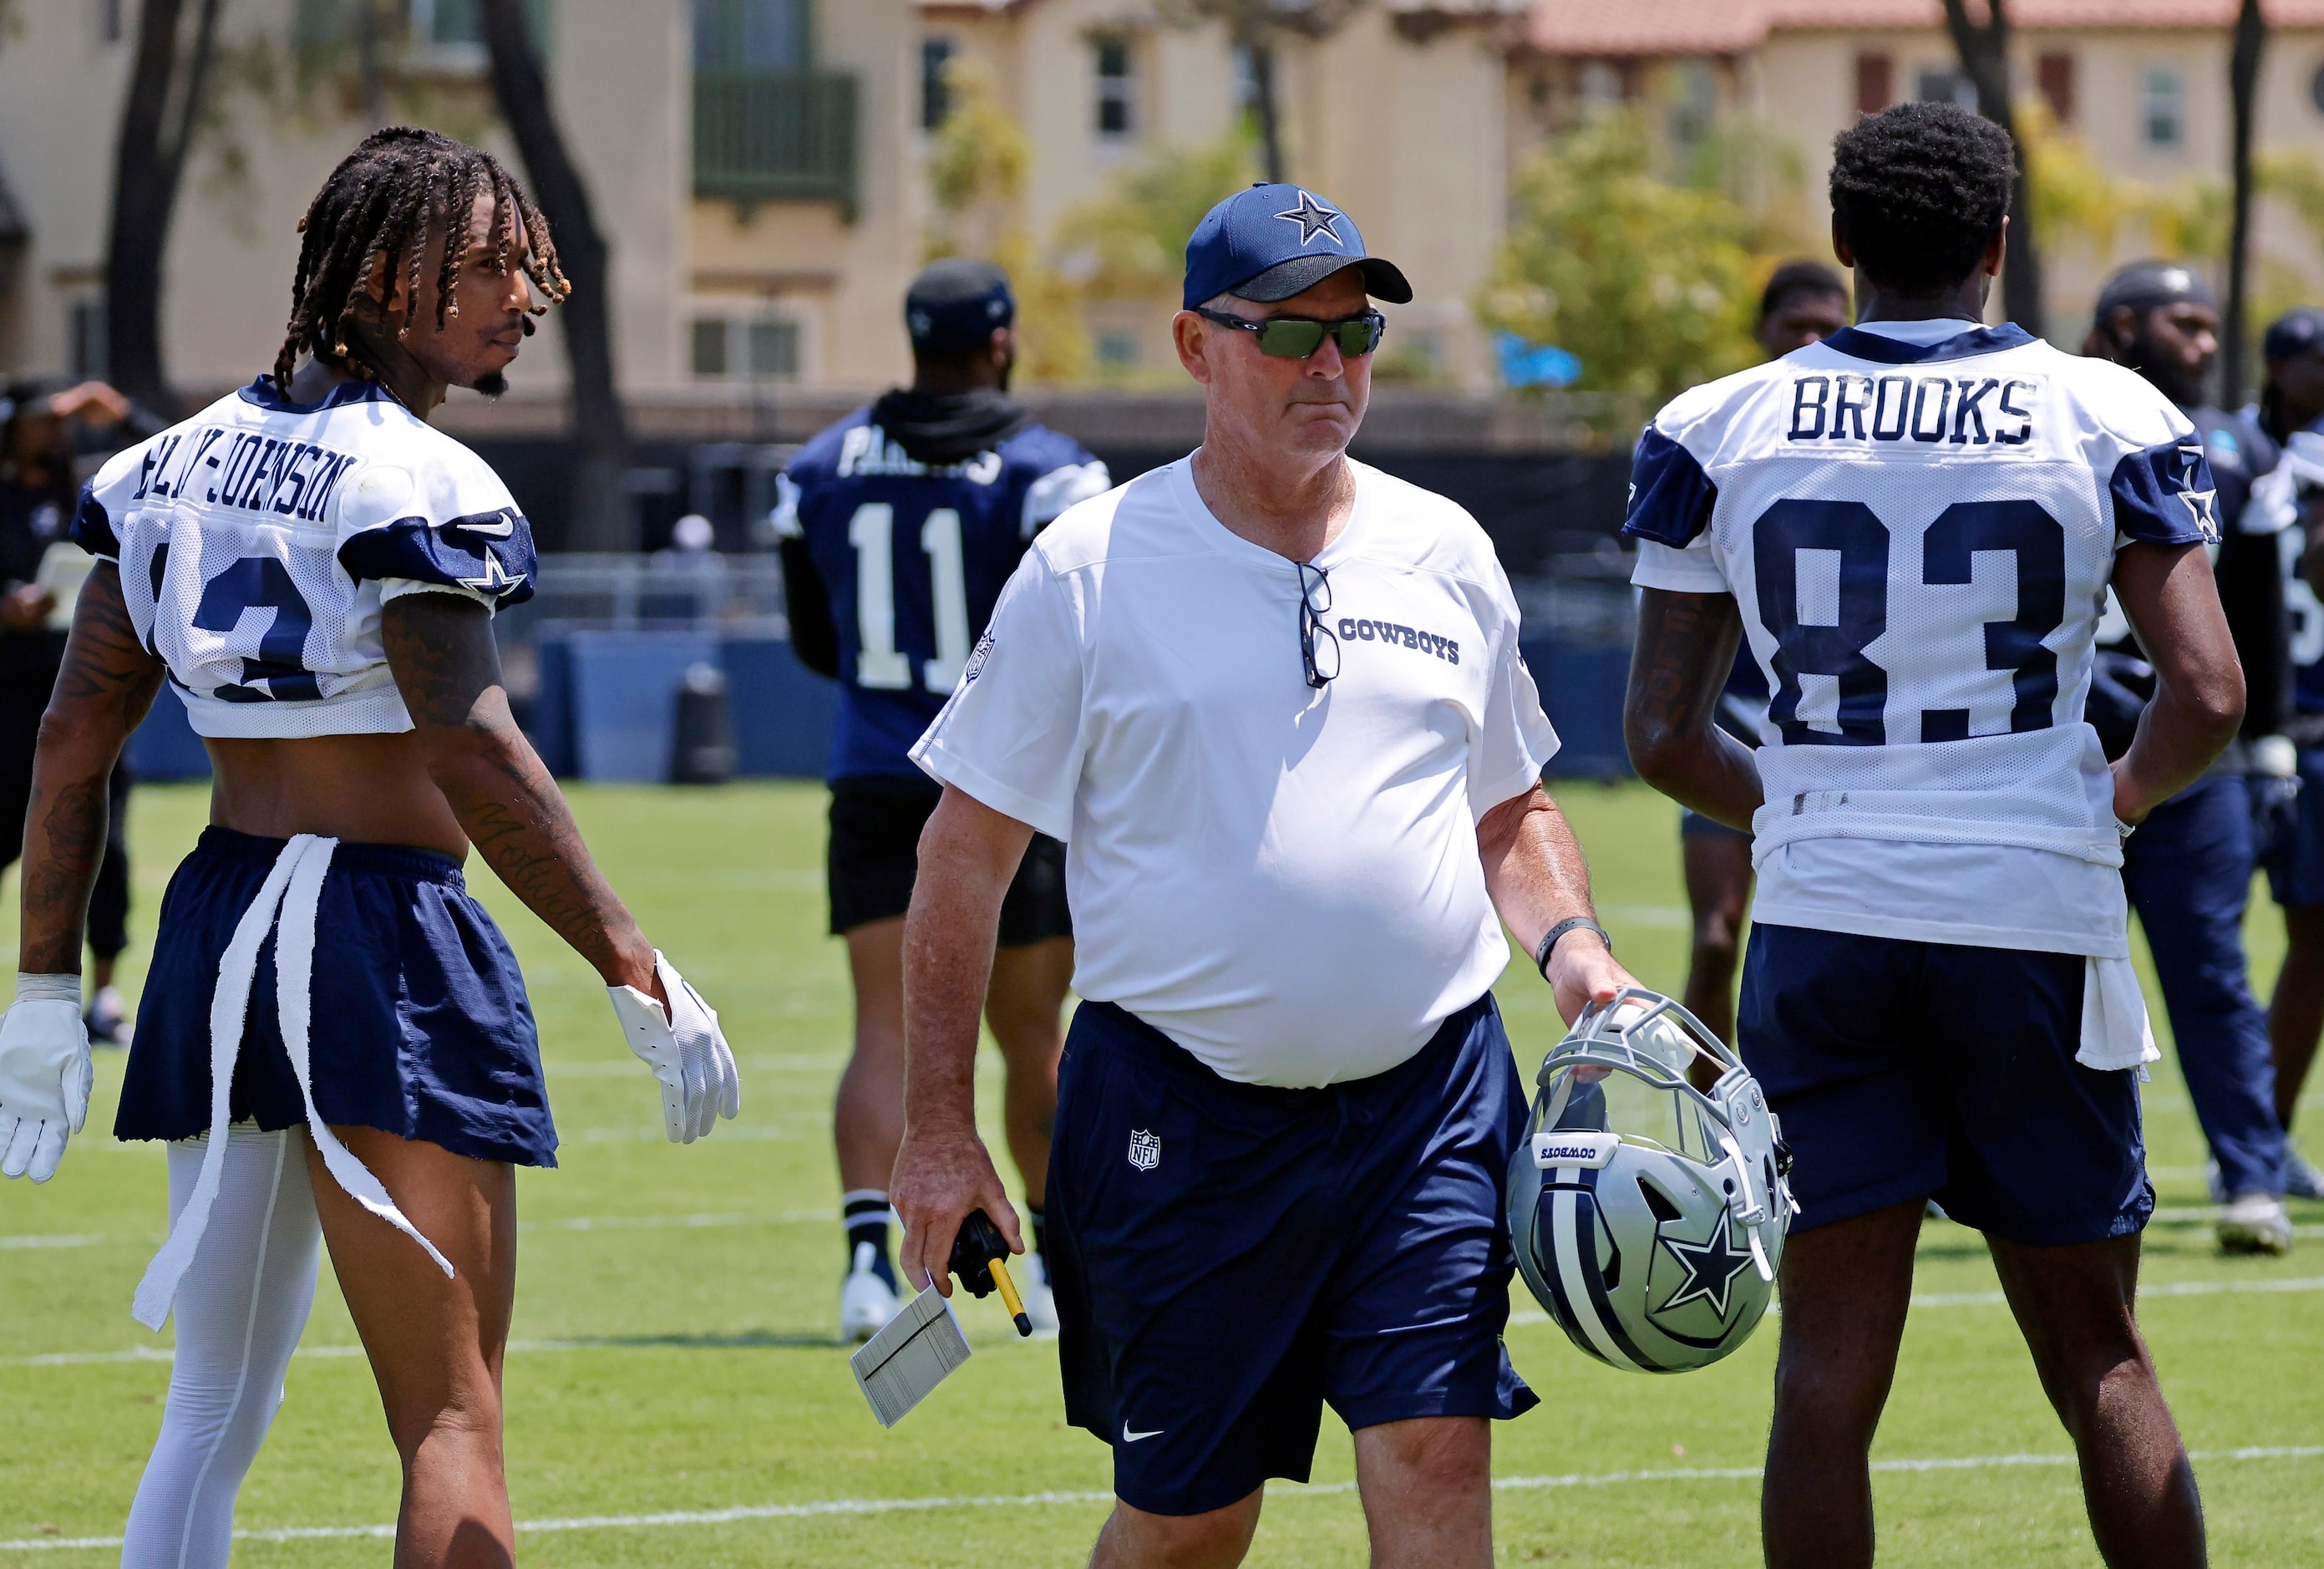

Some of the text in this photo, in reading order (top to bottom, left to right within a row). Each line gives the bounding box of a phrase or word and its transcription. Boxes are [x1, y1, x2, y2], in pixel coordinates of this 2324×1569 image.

[1788, 374, 2037, 444] BROOKS
[848, 502, 974, 697] 11
[1753, 498, 2066, 746] 83
[1338, 618, 1459, 666] COWBOYS
[1132, 1145, 1156, 1164] NFL
[1540, 1146, 1596, 1160] COWBOYS
